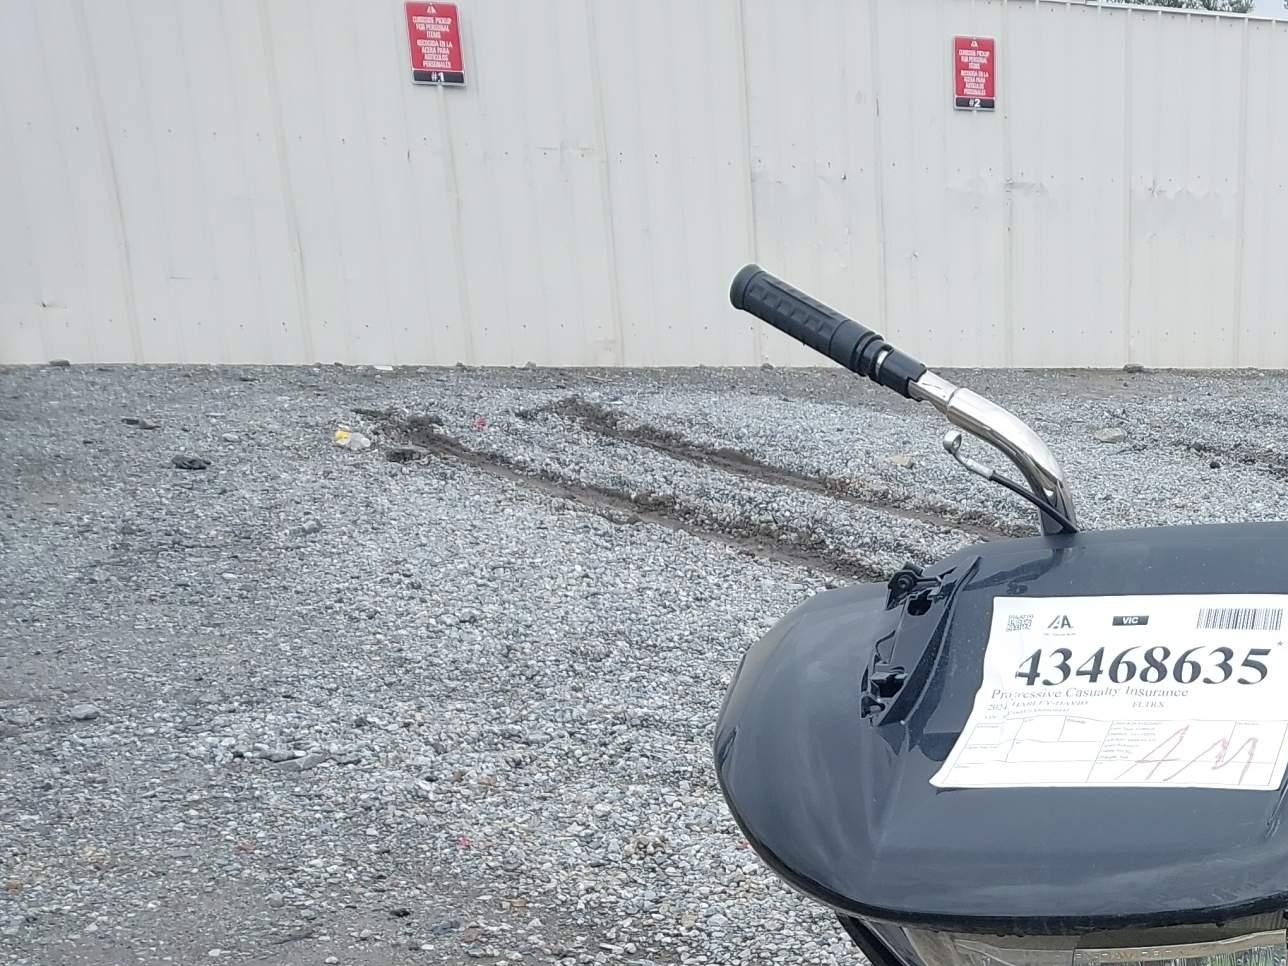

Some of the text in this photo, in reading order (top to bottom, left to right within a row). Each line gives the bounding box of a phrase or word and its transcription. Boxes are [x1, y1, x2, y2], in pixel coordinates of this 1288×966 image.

[431, 71, 444, 82] #1
[969, 98, 981, 107] #2
[1121, 616, 1139, 625] VIC
[1015, 645, 1272, 687] 43468635
[991, 685, 1189, 701] Progressive Casualty Insurance
